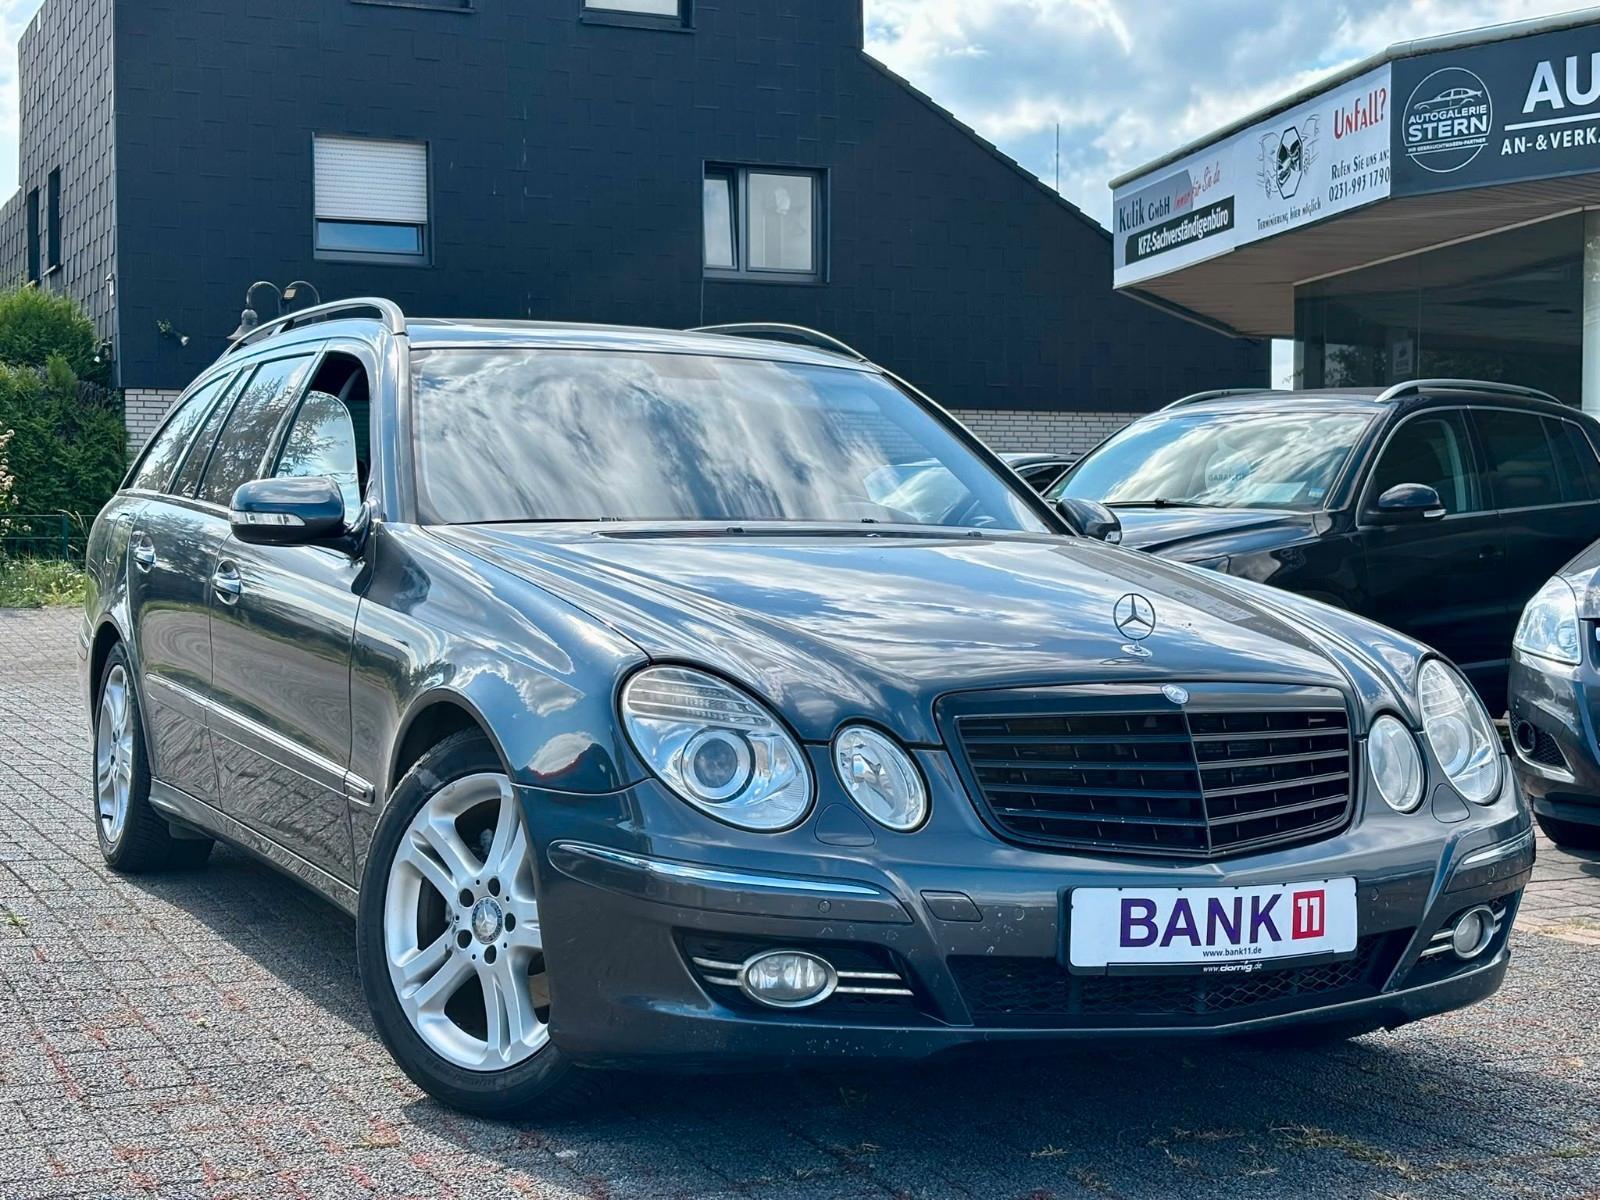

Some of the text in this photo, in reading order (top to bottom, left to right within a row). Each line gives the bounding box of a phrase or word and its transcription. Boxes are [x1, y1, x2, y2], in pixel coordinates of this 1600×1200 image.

[1522, 52, 1600, 114] AU
[1408, 105, 1487, 124] AUTOGALERIE
[1408, 115, 1487, 142] STERN
[1501, 127, 1600, 156] AN-&VERK
[1353, 154, 1364, 172] Sie
[1328, 166, 1390, 202] 0231-993 1790
[1119, 195, 1170, 232] Kulik GmbH
[1138, 207, 1229, 256] KFZ-Sachverständigenbüro
[1120, 894, 1321, 947] BANK 11
[1202, 946, 1263, 957] www.bank11.de
